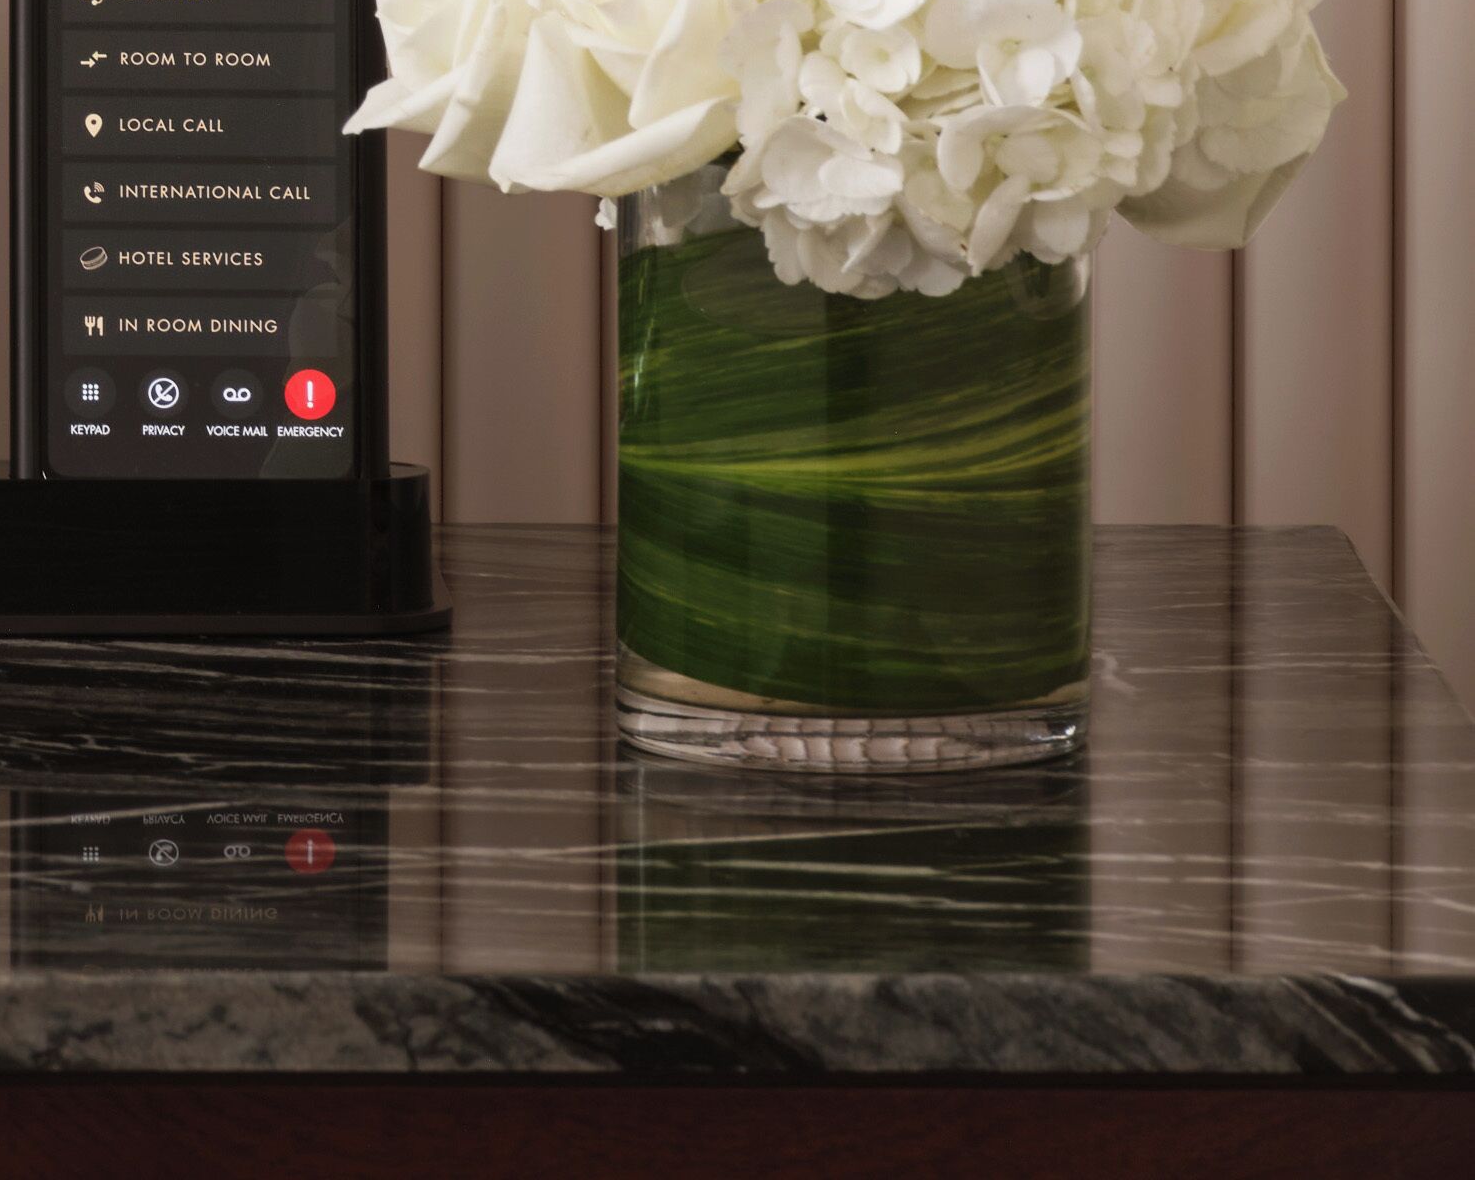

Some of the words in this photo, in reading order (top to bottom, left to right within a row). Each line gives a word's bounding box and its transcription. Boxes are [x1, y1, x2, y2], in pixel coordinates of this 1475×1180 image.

[121, 52, 175, 65] ROOM
[184, 53, 206, 65] TO
[216, 53, 270, 66] ROOM
[120, 119, 175, 131] LOCAL
[183, 119, 223, 132] CALL
[120, 185, 261, 199] INTERNATIONAL
[270, 186, 310, 199] CALL
[120, 252, 173, 265] HOTEL
[182, 252, 262, 265] SERVICES
[120, 319, 137, 331] IN
[147, 319, 202, 332] ROOM
[211, 319, 277, 333] DINING
[71, 424, 110, 435] KEYPAD
[143, 425, 185, 435] PRIVACY
[207, 426, 239, 436] VOICE
[243, 426, 268, 436] MAIL
[278, 426, 344, 437] EMERGENCY
